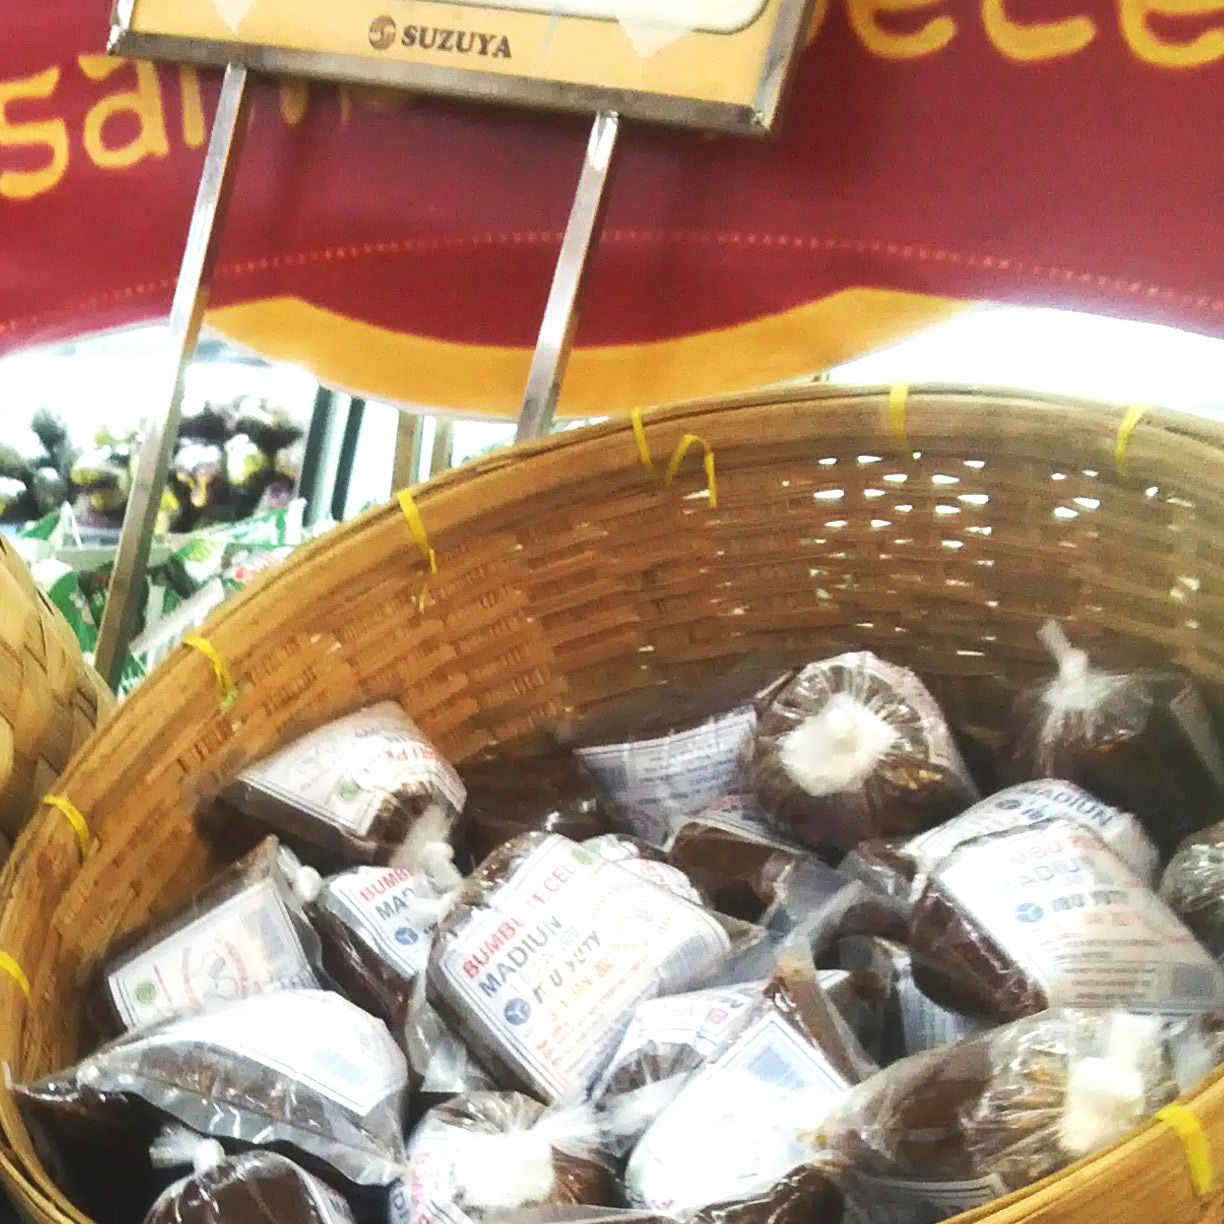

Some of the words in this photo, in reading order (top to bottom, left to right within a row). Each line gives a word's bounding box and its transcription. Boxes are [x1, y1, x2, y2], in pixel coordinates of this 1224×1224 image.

[401, 24, 513, 60] SUZUYA
[358, 866, 413, 902] BUMB
[475, 913, 563, 999] MADIUN
